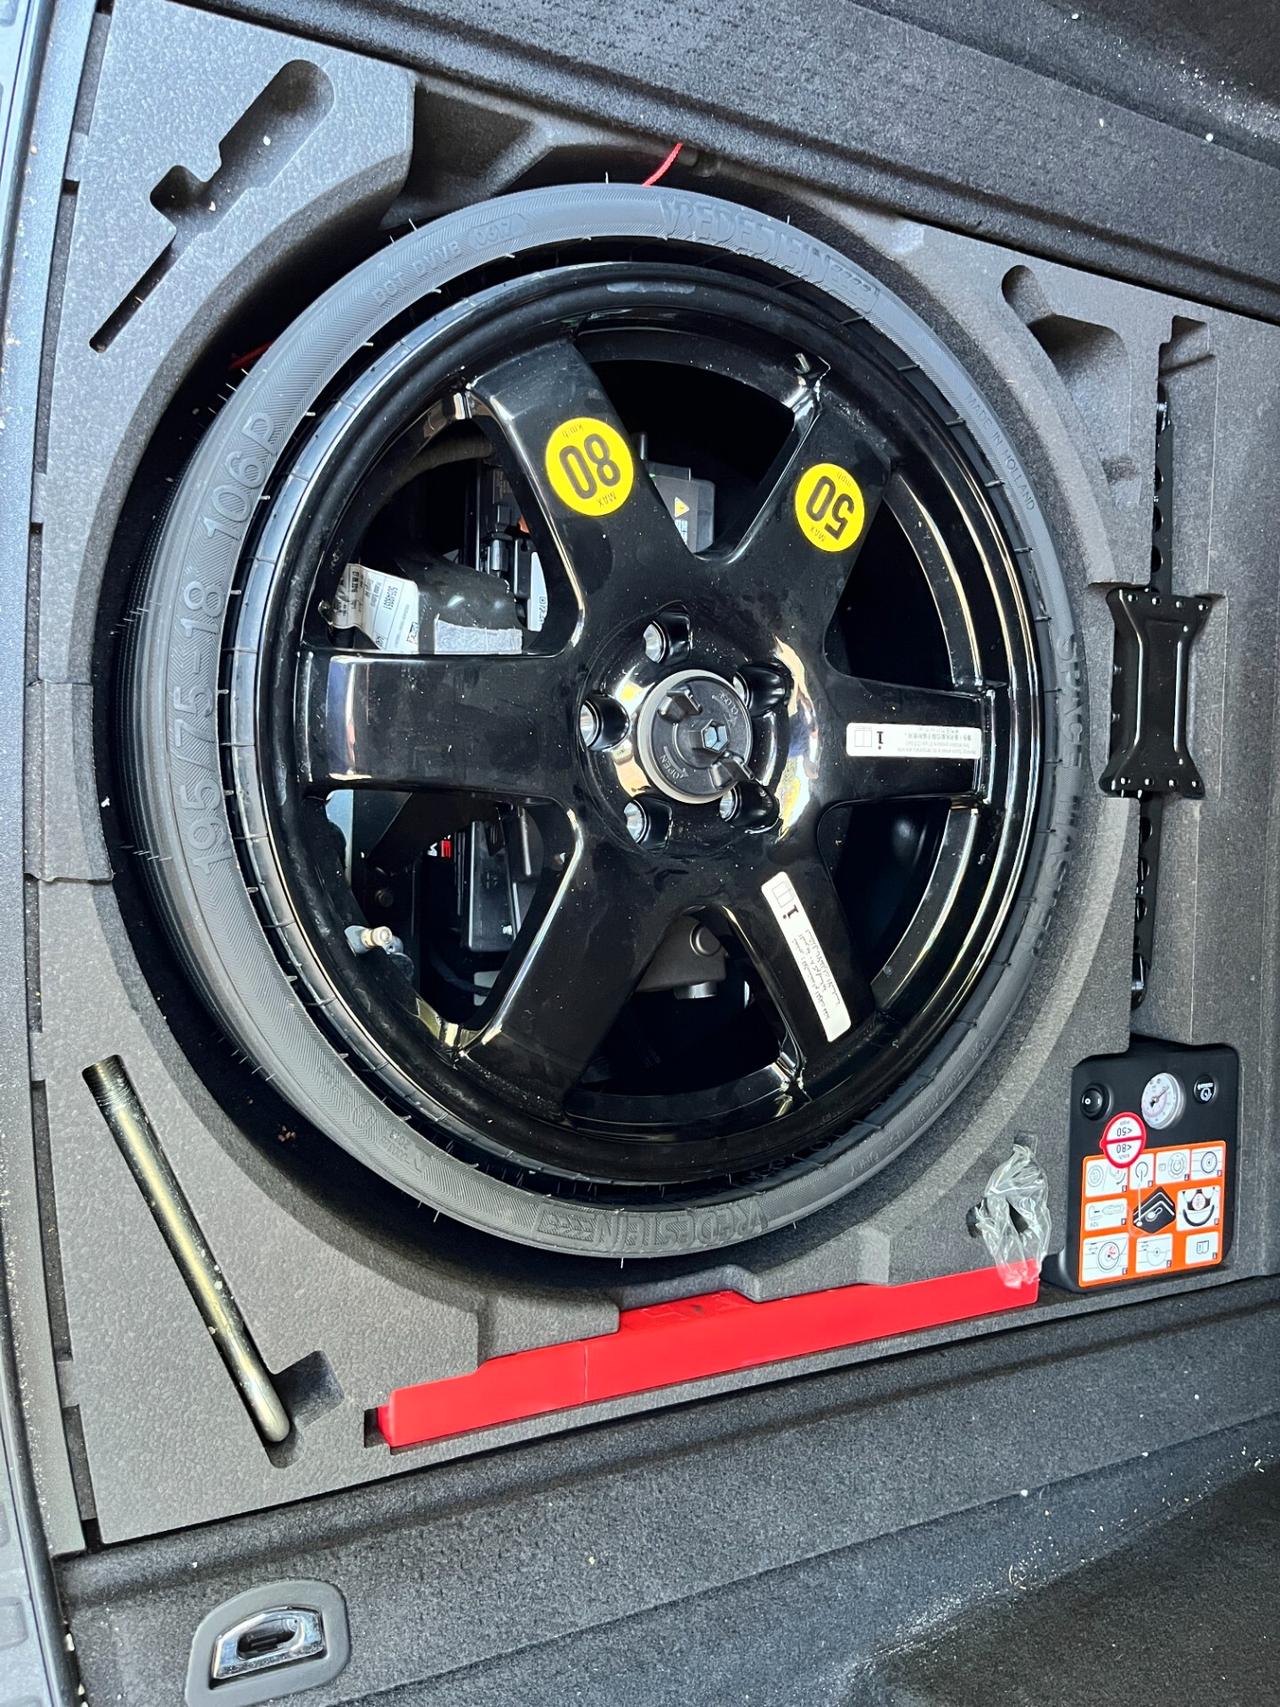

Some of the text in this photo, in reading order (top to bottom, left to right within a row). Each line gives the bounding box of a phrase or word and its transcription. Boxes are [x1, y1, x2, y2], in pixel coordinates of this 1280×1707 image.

[372, 273, 404, 303] DOT
[559, 434, 622, 500] 80
[965, 393, 1036, 511] MADE IN HOLLAND
[598, 492, 617, 507] MAX
[805, 475, 855, 541] 50
[809, 525, 826, 543] MAX
[173, 579, 232, 873] 195/75-18
[1057, 636, 1082, 769] SPACE
[659, 755, 684, 780] OPEN
[911, 1069, 965, 1127] TEMPORARY
[850, 1150, 879, 1177] ONLY
